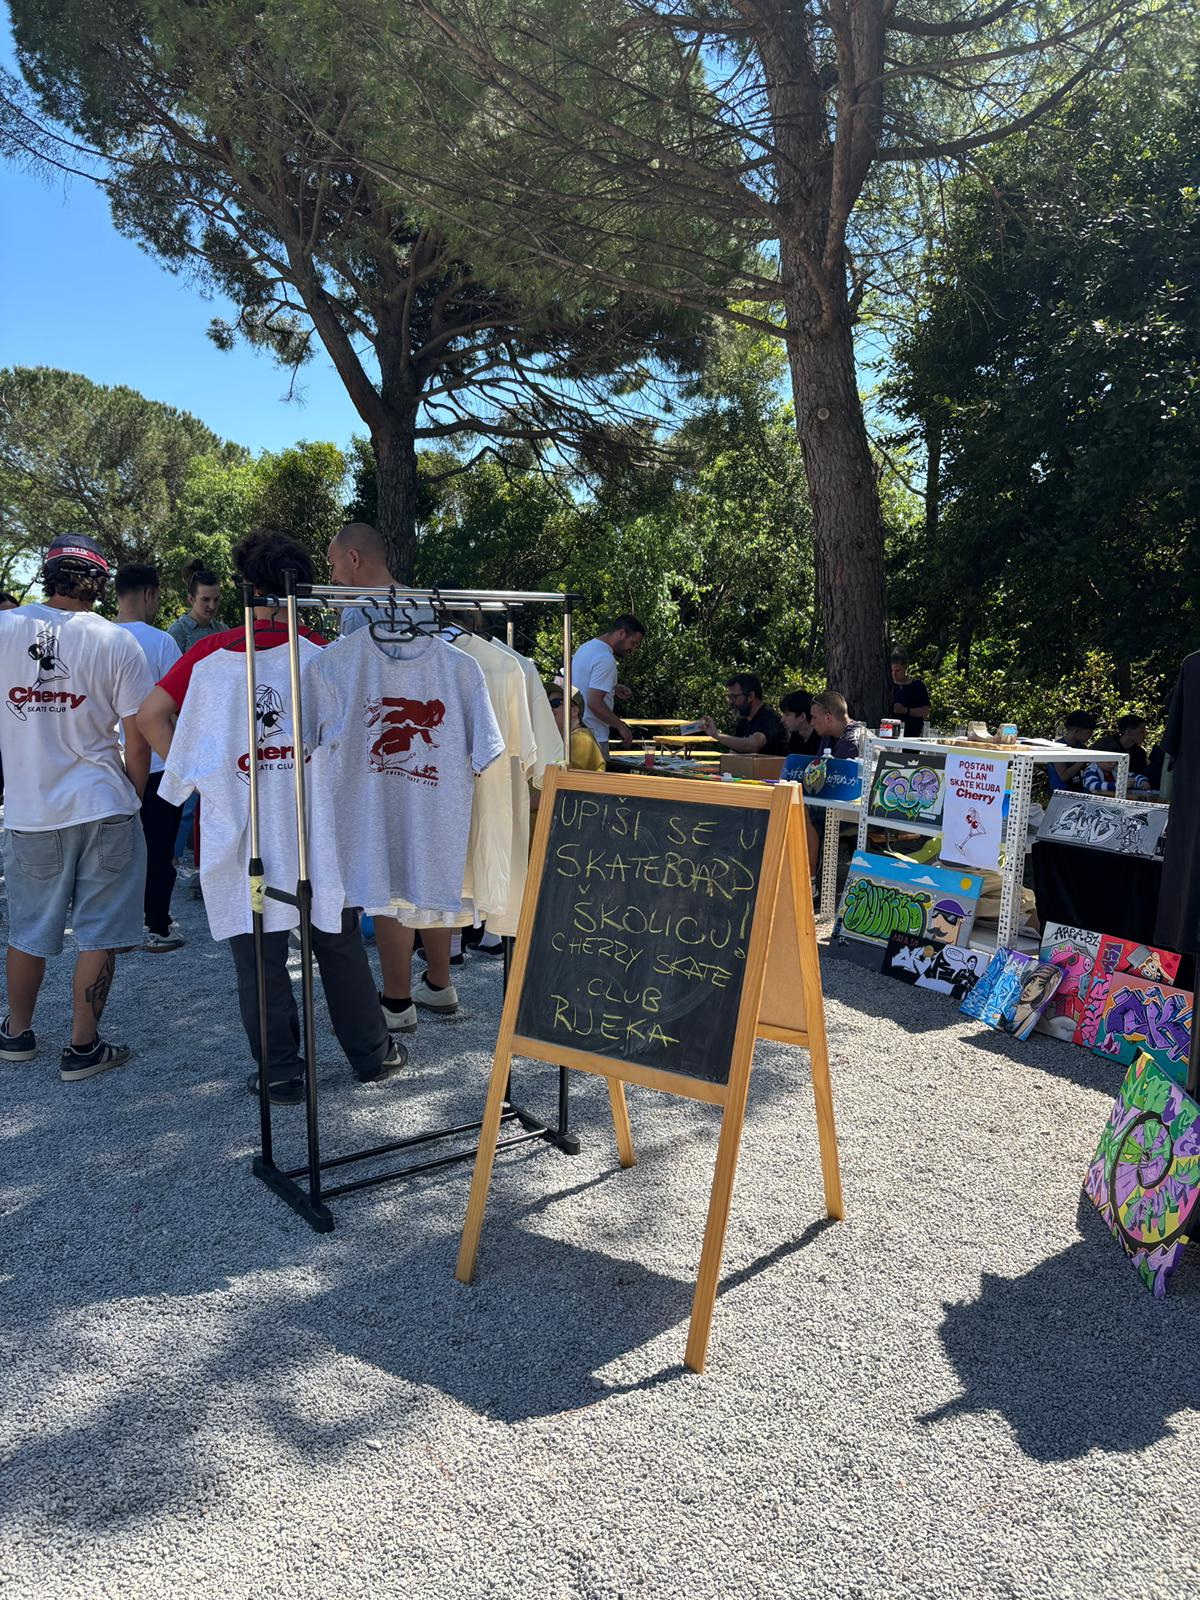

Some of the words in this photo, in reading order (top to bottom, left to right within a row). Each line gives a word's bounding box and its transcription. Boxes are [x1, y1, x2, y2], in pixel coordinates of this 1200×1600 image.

[8, 686, 87, 709] Cherry
[277, 763, 294, 771] CLU
[959, 761, 994, 772] POSTANI
[964, 769, 987, 781] ČLAN
[950, 778, 975, 789] SKATE
[975, 781, 1001, 793] KLUBA
[956, 788, 995, 805] Cherry
[561, 796, 640, 840] UPIŠI
[667, 817, 720, 846] SE
[741, 829, 758, 849] U
[556, 844, 755, 900] SKATEBOARD
[574, 882, 750, 959] ŠKOLICU!
[551, 933, 643, 972] CHERRY
[653, 954, 733, 988] SKATE
[587, 978, 662, 1012] CLUB
[551, 994, 680, 1048] RIJEKA
